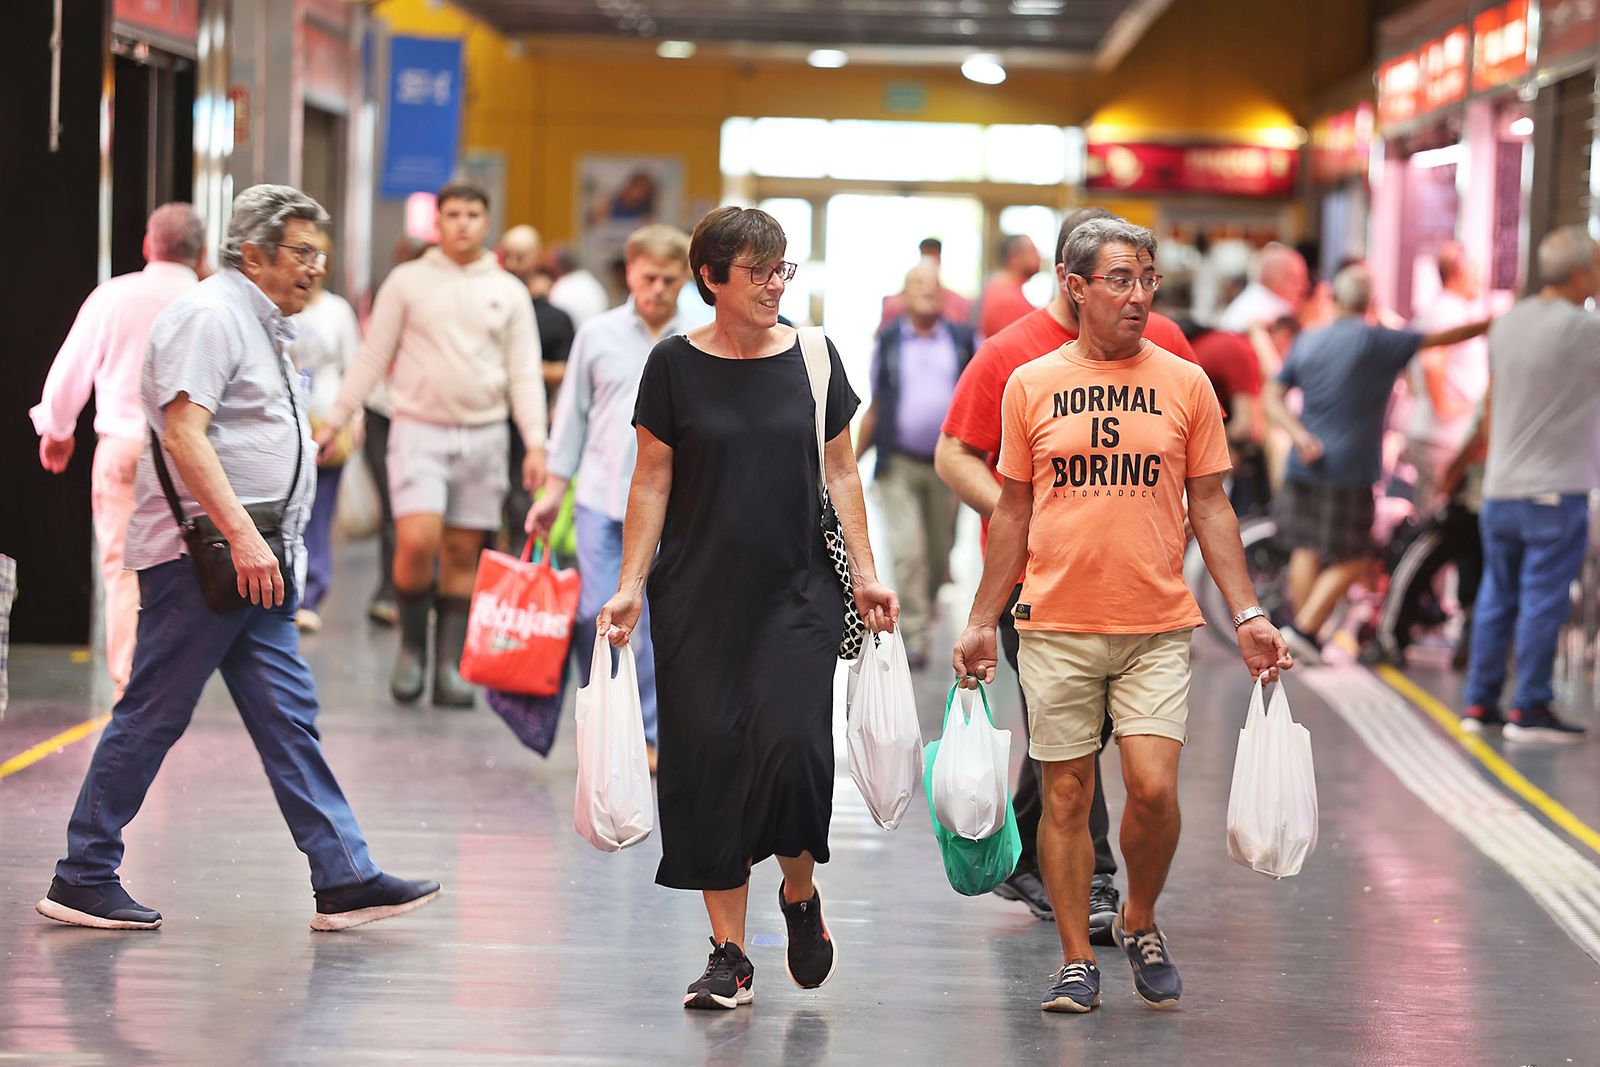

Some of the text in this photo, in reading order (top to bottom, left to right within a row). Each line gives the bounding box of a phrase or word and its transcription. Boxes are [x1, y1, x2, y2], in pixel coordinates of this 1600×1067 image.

[1053, 385, 1162, 418] NORMAL
[1091, 417, 1120, 448] IS
[1051, 453, 1161, 487] BORING
[1053, 489, 1157, 498] ALTONADOCK
